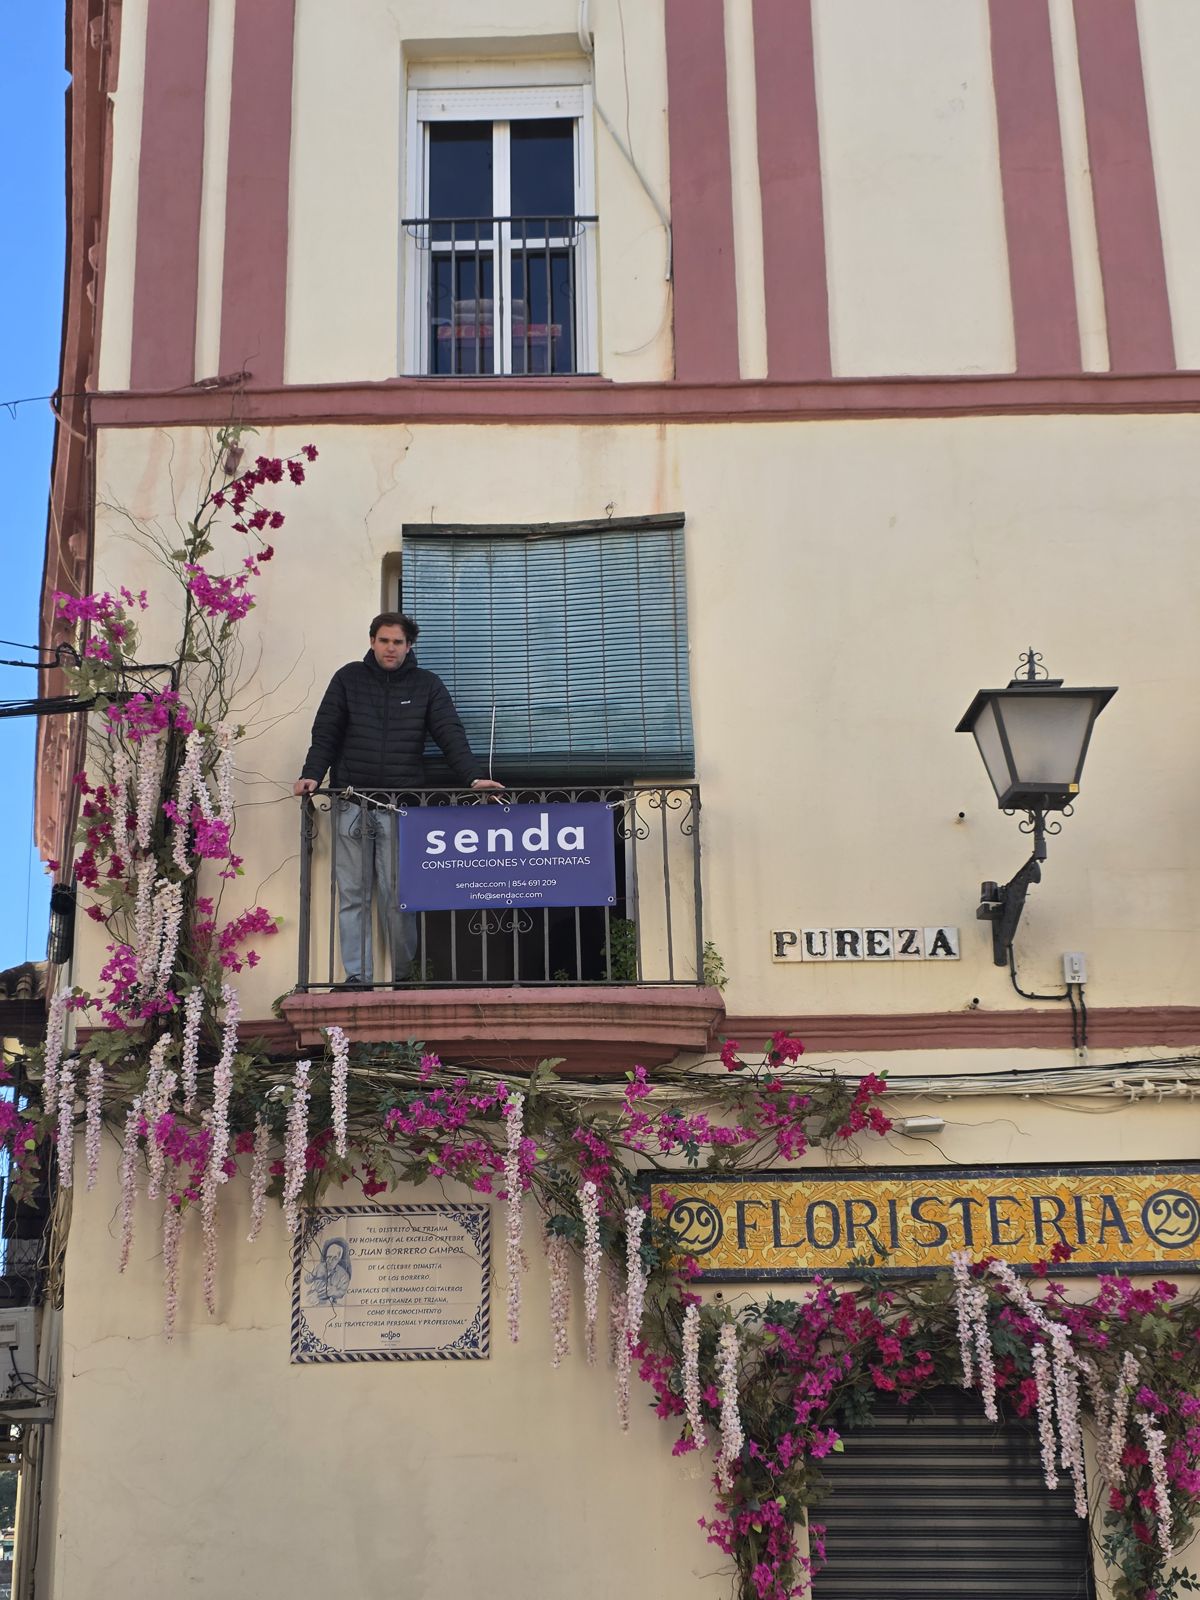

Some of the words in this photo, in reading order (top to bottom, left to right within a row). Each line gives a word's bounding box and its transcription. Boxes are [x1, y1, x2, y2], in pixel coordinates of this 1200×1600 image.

[425, 812, 585, 855] senda
[421, 859, 518, 870] CONSTRUCCIONES
[519, 858, 528, 867] Y
[529, 856, 591, 866] CONTRATAS
[455, 880, 507, 889] sendacc.com
[512, 880, 527, 888] 854
[542, 879, 557, 887] 209
[469, 890, 543, 900] info@sendacc.com
[773, 928, 957, 957] PUREZA
[674, 1206, 716, 1245] 29
[735, 1194, 1133, 1251] FLORISTERIA
[1152, 1198, 1197, 1236] 29
[359, 1236, 394, 1244] HOMENAJE
[359, 1247, 383, 1257] JUAN
[385, 1247, 427, 1256] BORRERO
[344, 1320, 385, 1328] TRAYECTORIA
